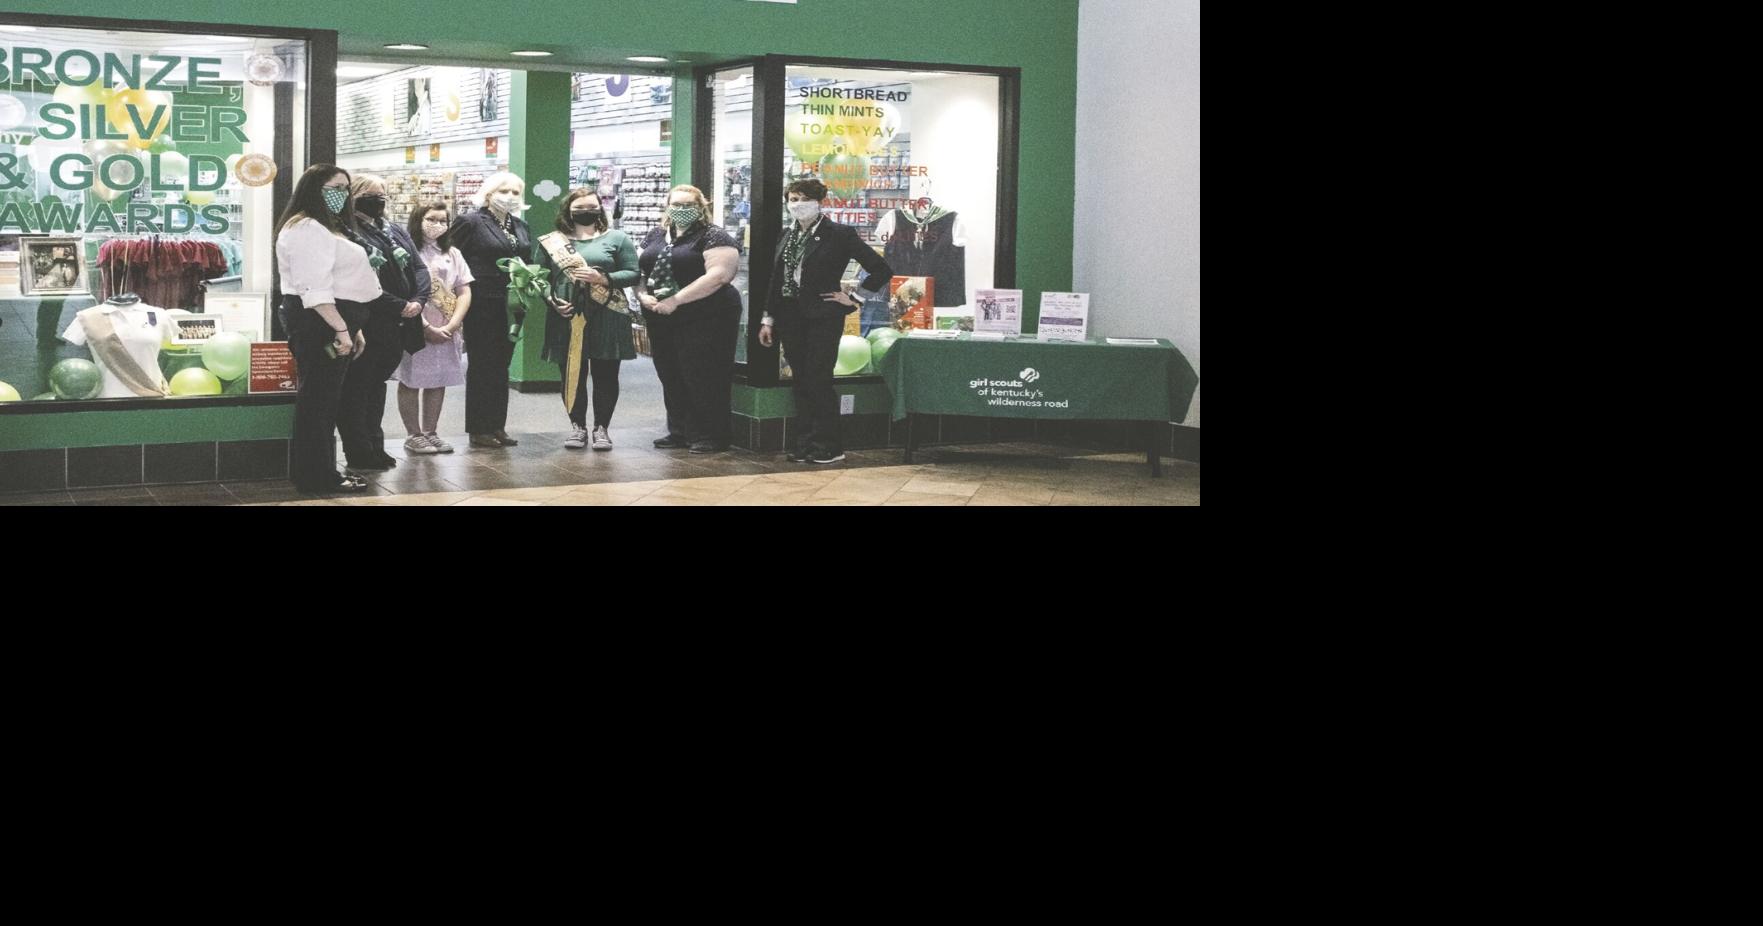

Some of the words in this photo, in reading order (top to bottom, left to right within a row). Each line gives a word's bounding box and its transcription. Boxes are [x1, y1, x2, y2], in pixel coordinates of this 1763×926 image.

[0, 47, 242, 102] RONZE,
[800, 86, 908, 102] SHORTBREAD
[800, 103, 835, 116] THIN
[838, 105, 885, 118] MINTS
[38, 102, 250, 143] SILVER
[800, 123, 895, 138] TOAST-YAY
[0, 152, 29, 191] &
[49, 153, 228, 192] GOLD
[868, 198, 929, 210] BUTTER
[0, 201, 230, 235] AWARDS
[969, 378, 988, 389] girl
[989, 380, 1024, 388] scouts
[977, 387, 989, 396] of
[990, 388, 1044, 400] kentucky's
[987, 397, 1042, 407] wilderness
[1044, 399, 1069, 408] road
